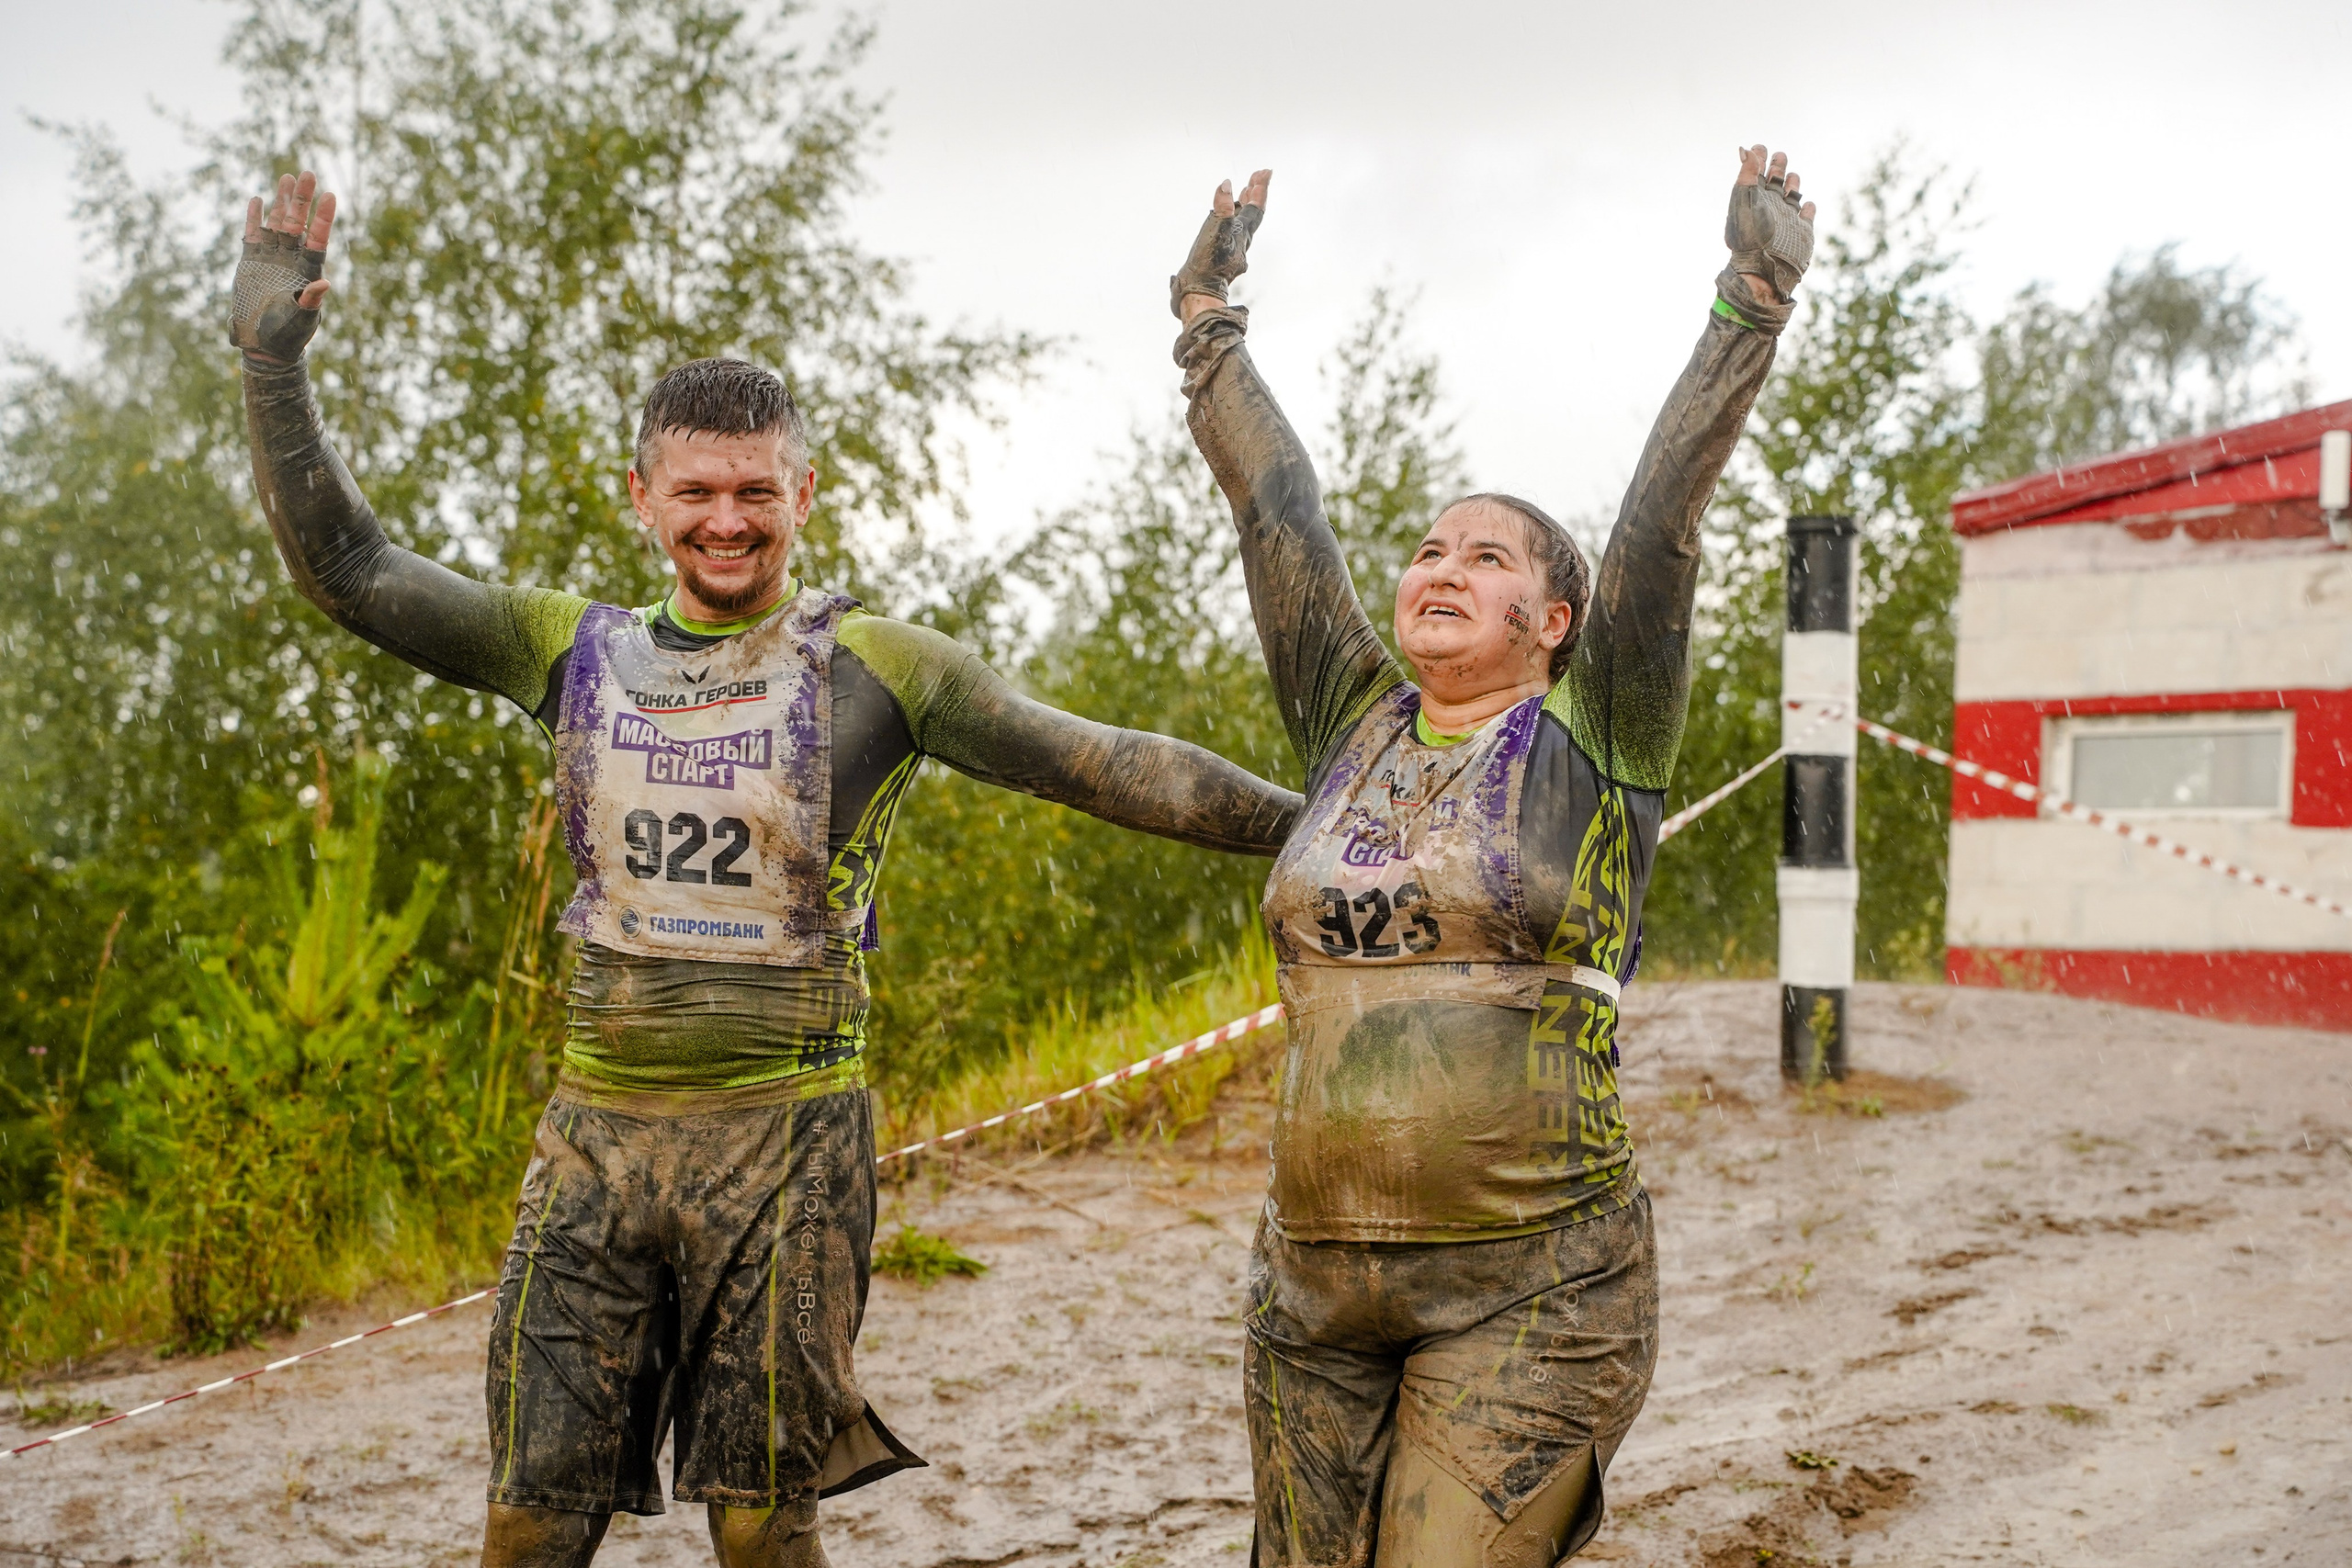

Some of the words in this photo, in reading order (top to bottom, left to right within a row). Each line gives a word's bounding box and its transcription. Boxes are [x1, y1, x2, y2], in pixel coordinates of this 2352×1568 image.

[694, 681, 767, 705] ГЕРОЕВ
[651, 752, 729, 785] СТАРТ
[625, 808, 752, 887] 922
[650, 916, 764, 940] ГАЗПРОМБАНК
[1317, 881, 1442, 957] 923
